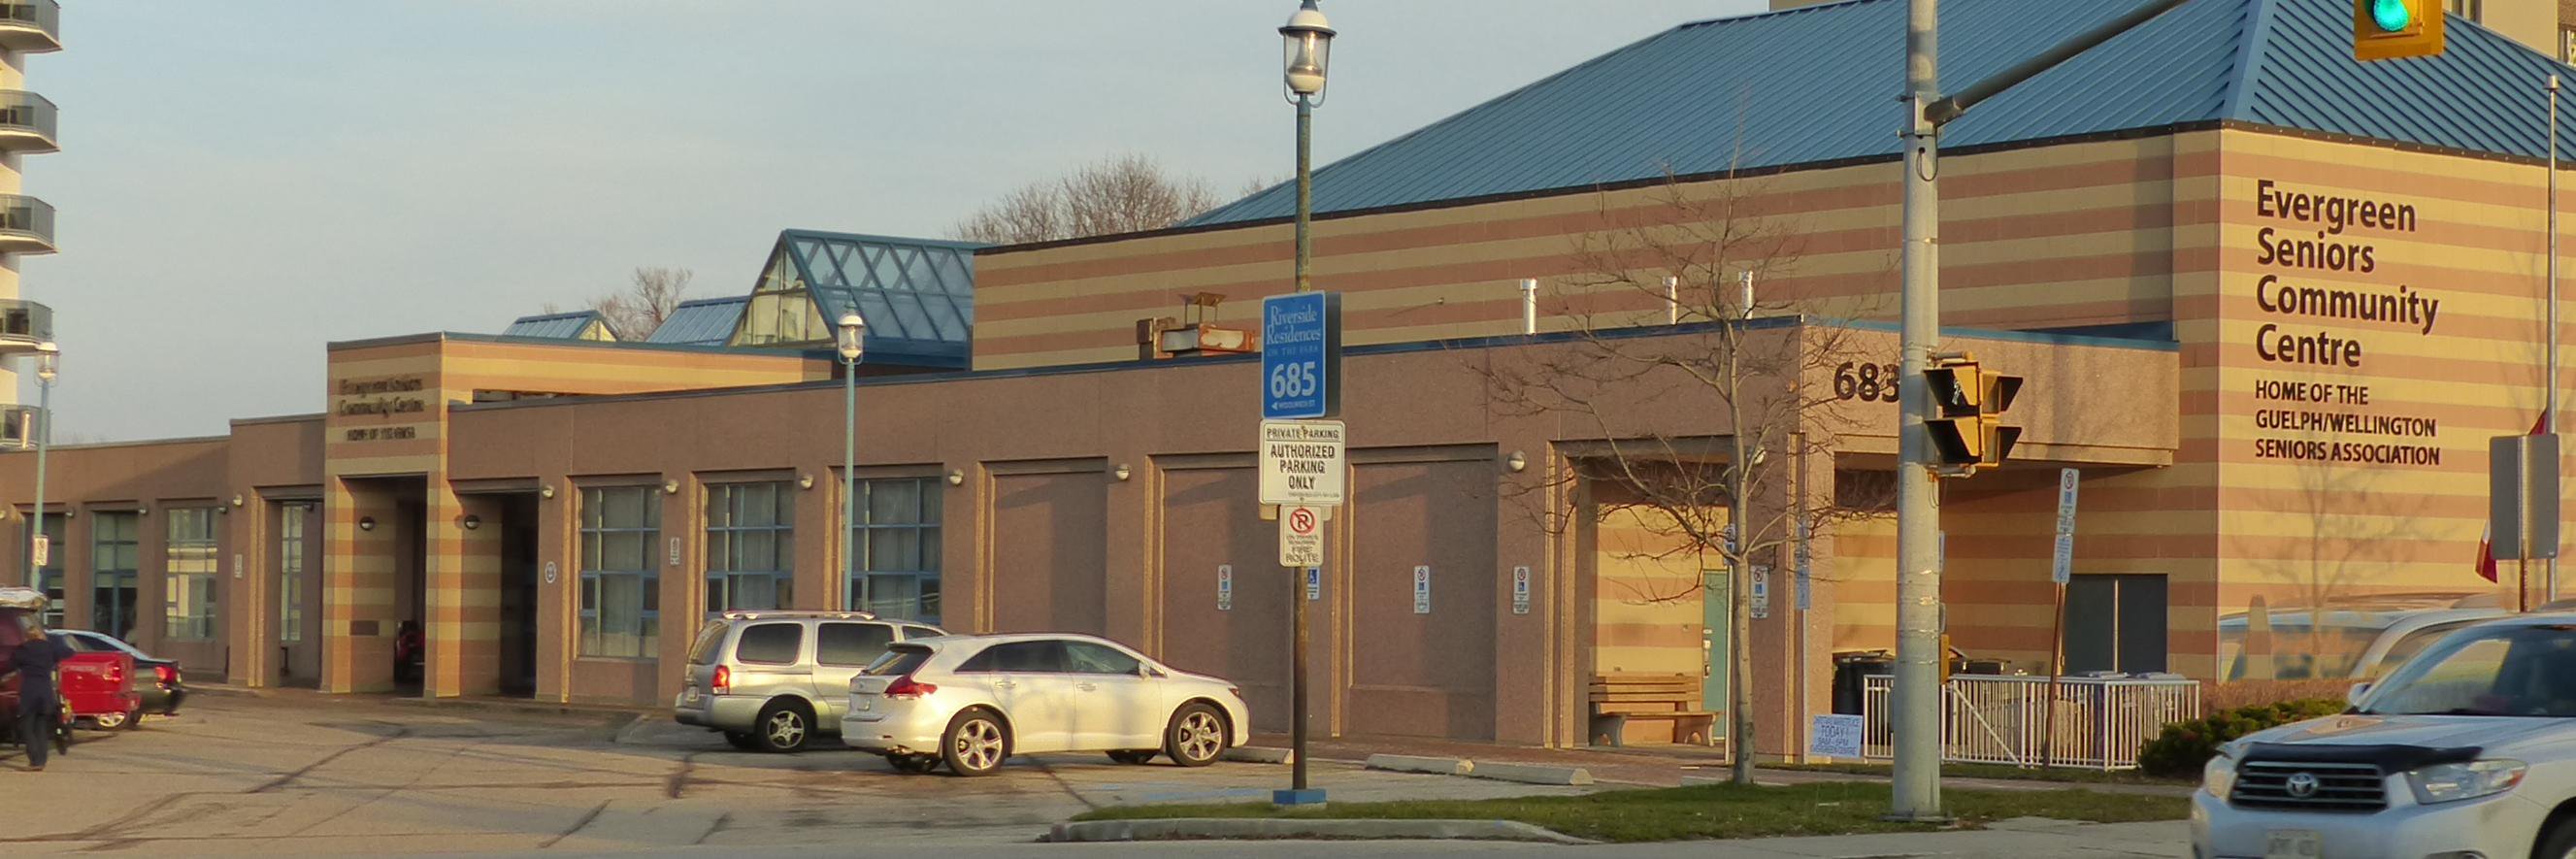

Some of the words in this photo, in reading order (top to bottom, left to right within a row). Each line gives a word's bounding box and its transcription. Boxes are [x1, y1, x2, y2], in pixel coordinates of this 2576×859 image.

[2257, 179, 2416, 235] Evergreen
[2257, 227, 2374, 273] Seniors
[1271, 304, 1317, 327] Riverside
[2257, 275, 2439, 336] Community
[1266, 324, 1321, 346] Residences
[2257, 323, 2361, 368] Centre
[1271, 360, 1316, 399] 685
[1833, 361, 1899, 403] 683
[2256, 380, 2306, 402] HOME
[2310, 383, 2332, 403] OF
[2336, 385, 2368, 405] THE
[1267, 427, 1302, 439] PRIVATE
[1303, 428, 1339, 439] PARKING
[2256, 410, 2436, 437] GUELPH/WELLINGTON
[1271, 444, 1336, 459] AUTHORIZED
[2256, 439, 2327, 461] SENIORS
[2330, 443, 2440, 466] ASSOCIATION
[1279, 459, 1326, 475] PARKING
[1288, 475, 1315, 489] ONLY
